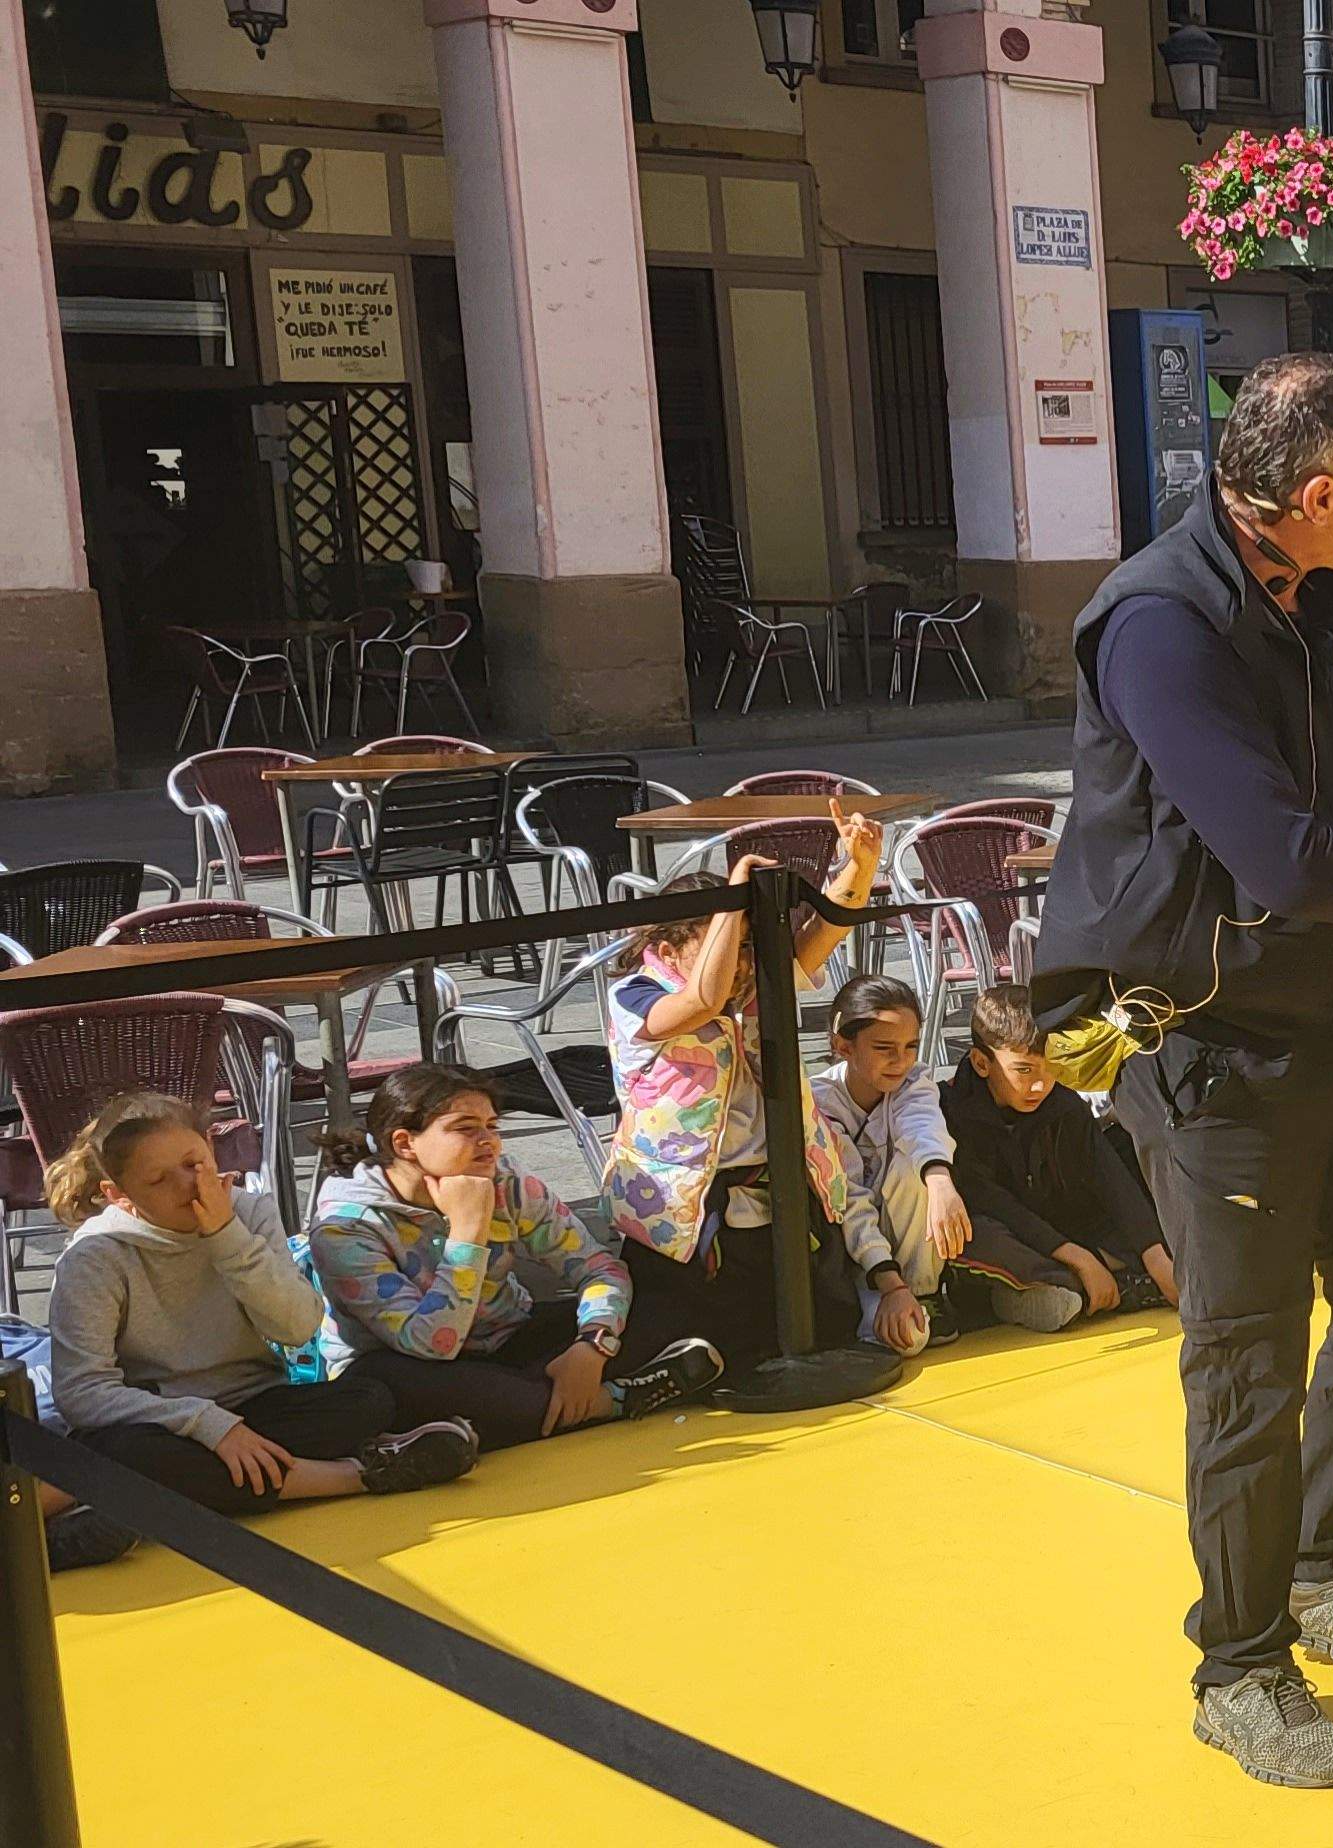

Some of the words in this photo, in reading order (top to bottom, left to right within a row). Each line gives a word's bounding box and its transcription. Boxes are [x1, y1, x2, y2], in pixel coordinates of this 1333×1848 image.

[1036, 215, 1069, 229] PLAZA
[1071, 219, 1083, 229] DE
[1051, 230, 1079, 243] LUIS
[277, 279, 302, 295] ME
[304, 278, 333, 295] PIDIÓ
[340, 282, 354, 294] UN
[355, 279, 388, 295] CAFÉ
[281, 300, 291, 315] Y
[298, 302, 313, 315] LE
[360, 303, 393, 316] SOLO
[321, 340, 388, 358] HERMOSO!
